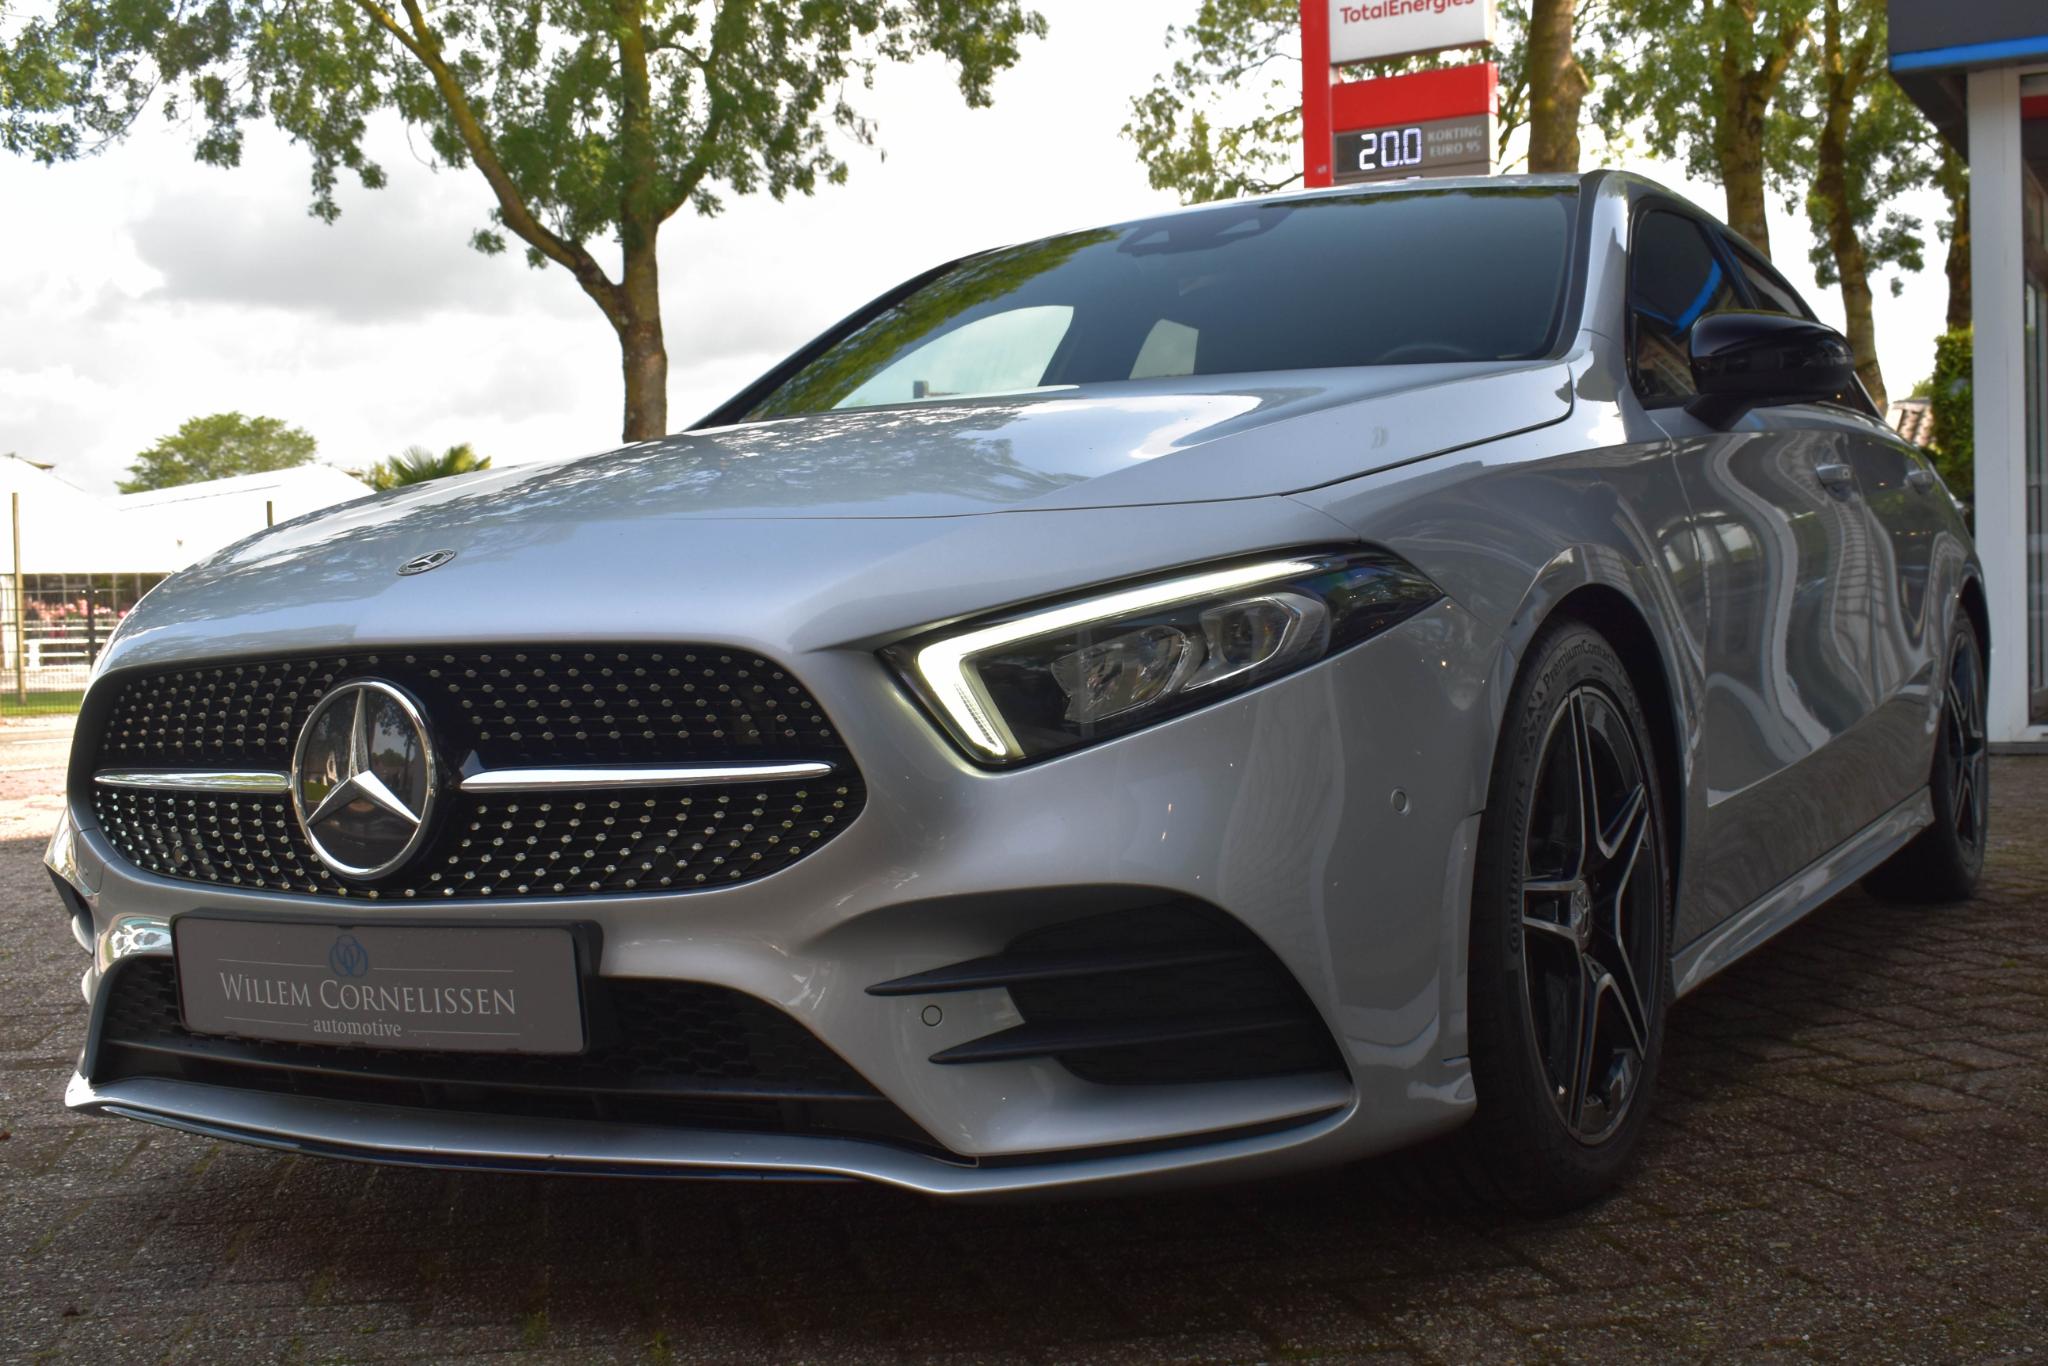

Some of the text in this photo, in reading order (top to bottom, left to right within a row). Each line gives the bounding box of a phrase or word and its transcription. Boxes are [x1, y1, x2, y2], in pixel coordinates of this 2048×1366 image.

[1427, 125, 1483, 142] KORTING
[1358, 127, 1422, 170] 20.0
[1430, 142, 1464, 157] EURO
[219, 972, 516, 1015] WILLEM CORNELISSEN
[313, 1018, 402, 1037] automotive
